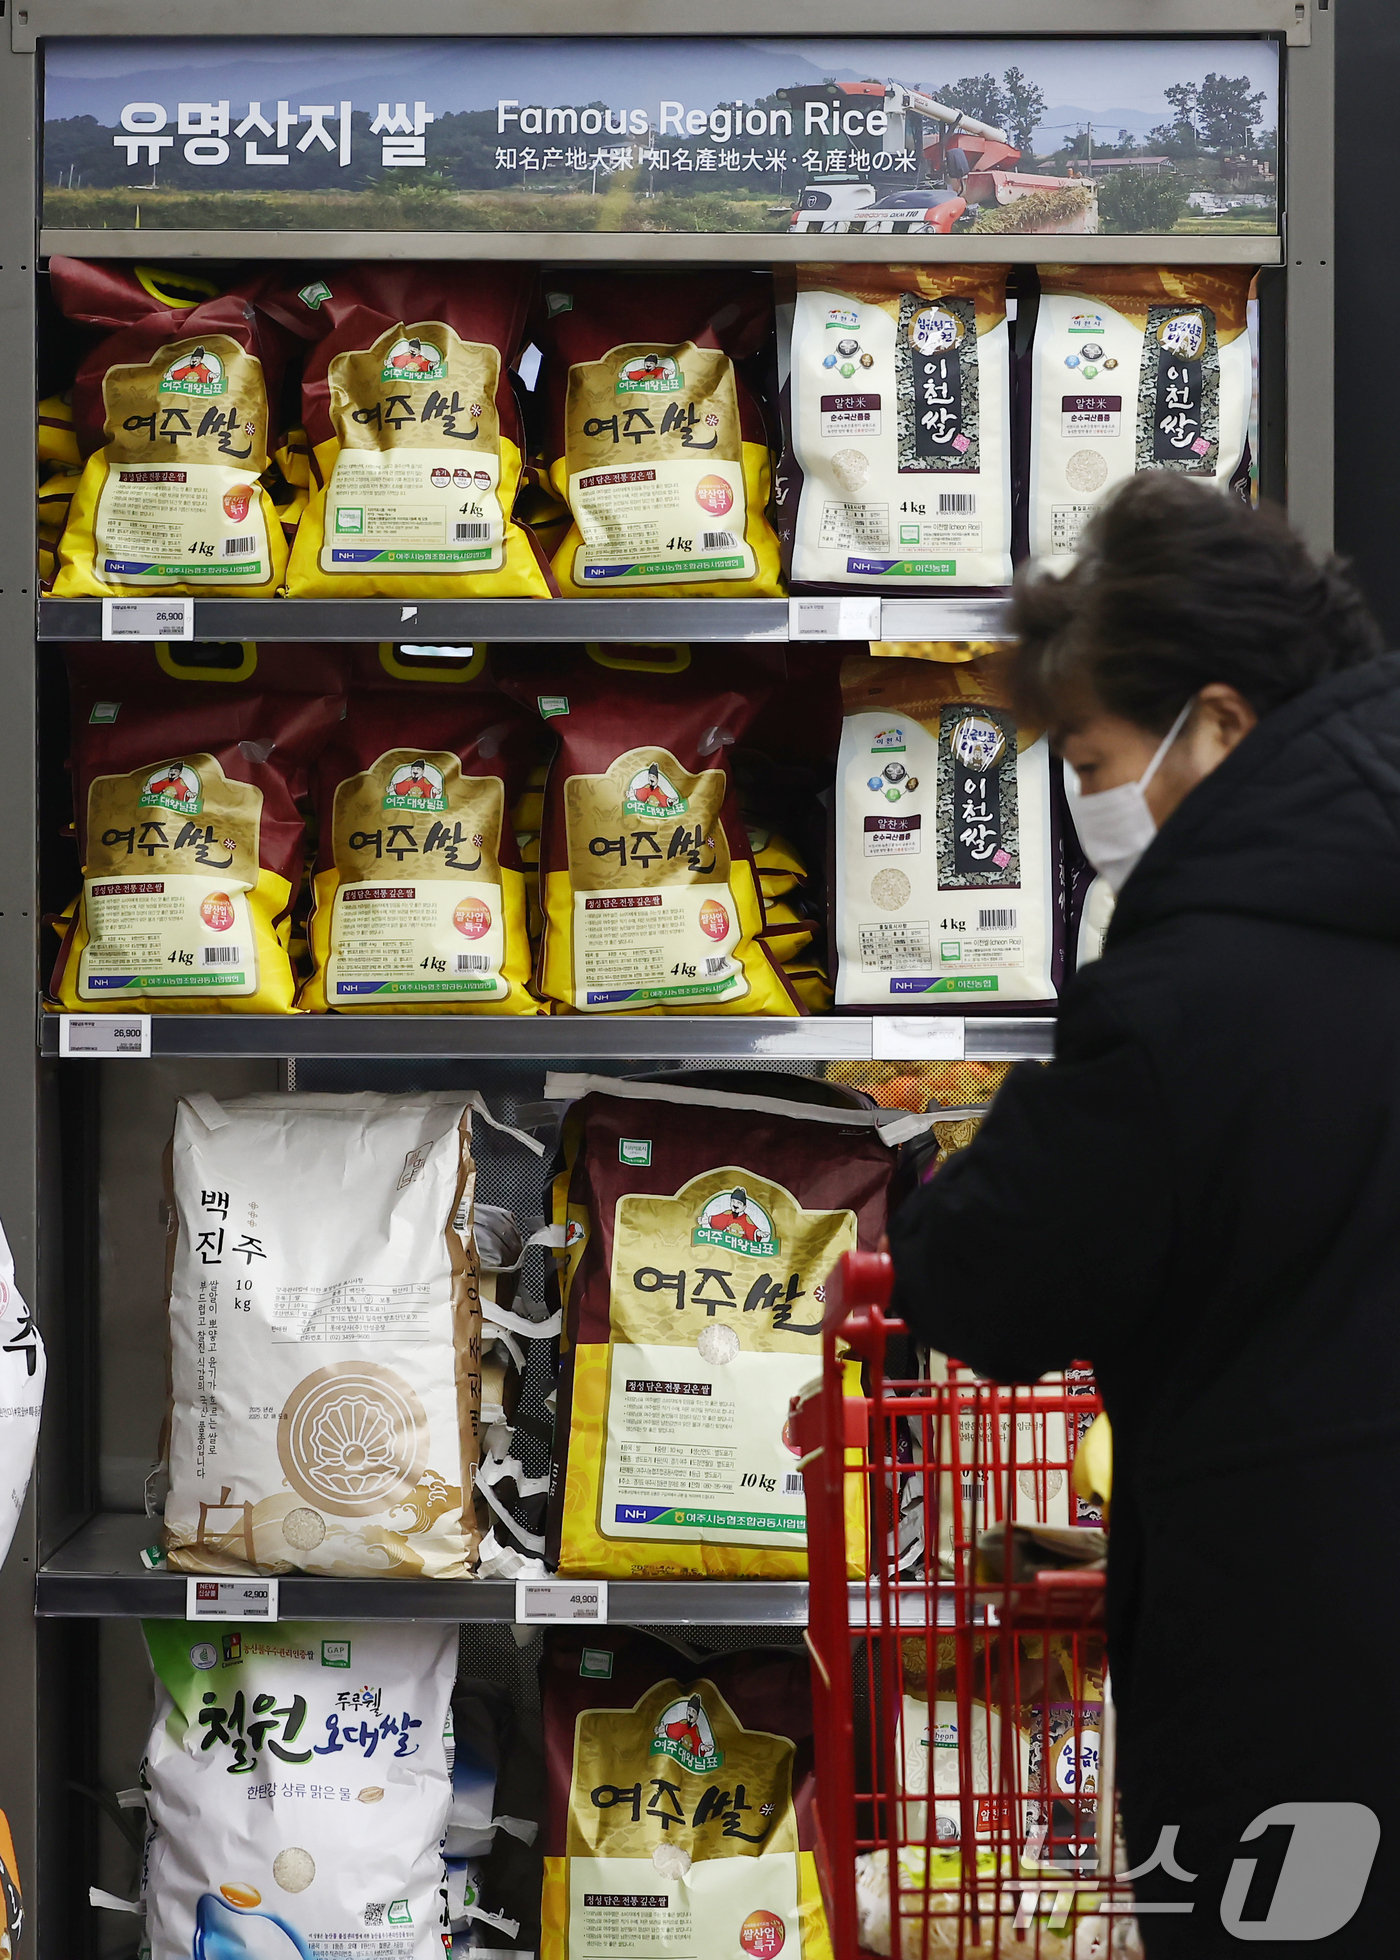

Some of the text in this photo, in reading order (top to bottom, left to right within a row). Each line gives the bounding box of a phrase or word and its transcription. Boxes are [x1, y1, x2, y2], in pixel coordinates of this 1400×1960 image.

[497, 101, 889, 142] Famous Region Rice
[113, 100, 435, 167] 유명산지 쌀
[384, 368, 443, 379] 여주 대왕님표
[162, 382, 223, 394] 여주 대왕님표
[619, 380, 680, 391] 여주 대왕님표
[921, 358, 957, 444] 이천쌀
[1159, 366, 1198, 448] 이천쌀
[459, 502, 484, 517] 4 kg
[900, 501, 926, 516] 4 kg
[188, 541, 215, 557] 4 kg
[666, 536, 693, 552] 4 kg
[109, 563, 125, 571] NH
[853, 562, 870, 571] NH
[156, 612, 183, 622] 26,900
[141, 795, 198, 814] 여주 대왕님표
[386, 797, 444, 810] 여주 대왕님표
[626, 802, 685, 816] 여주 대왕님표
[959, 777, 997, 860] 이천쌀
[940, 918, 966, 932] 4 kg
[168, 950, 194, 966] 4 kg
[420, 957, 447, 972] 4 kg
[671, 962, 697, 978] 4 kg
[95, 978, 108, 986] NH
[593, 993, 609, 1001] NH
[113, 1029, 141, 1038] 26,900
[697, 1229, 774, 1255] 여주 대왕님표
[236, 1279, 253, 1291] 10
[197, 1281, 207, 1326] 부드럽고
[208, 1279, 219, 1315] 쌀알이
[234, 1297, 251, 1312] kg
[197, 1330, 206, 1354] 찰진
[208, 1319, 218, 1352] 뽀얗고
[208, 1356, 217, 1391] 윤기가
[628, 1381, 710, 1395] 정성 담은 전통 깊은 쌀
[208, 1432, 217, 1455] 쌀로
[196, 1425, 206, 1480] 품종입니다
[739, 1473, 777, 1492] 10 kg
[625, 1509, 646, 1519] NH
[243, 1590, 268, 1599] 42,900
[569, 1595, 598, 1604] 49,900
[327, 1646, 345, 1654] GAP
[198, 1690, 423, 1775] 철원 오대쌀
[654, 1740, 718, 1770] 여주 대왕님표
[247, 1782, 351, 1802] 한탄강 상류 맑은 물
[743, 1927, 775, 1940] 쌀산업
[753, 1939, 776, 1951] 특구
